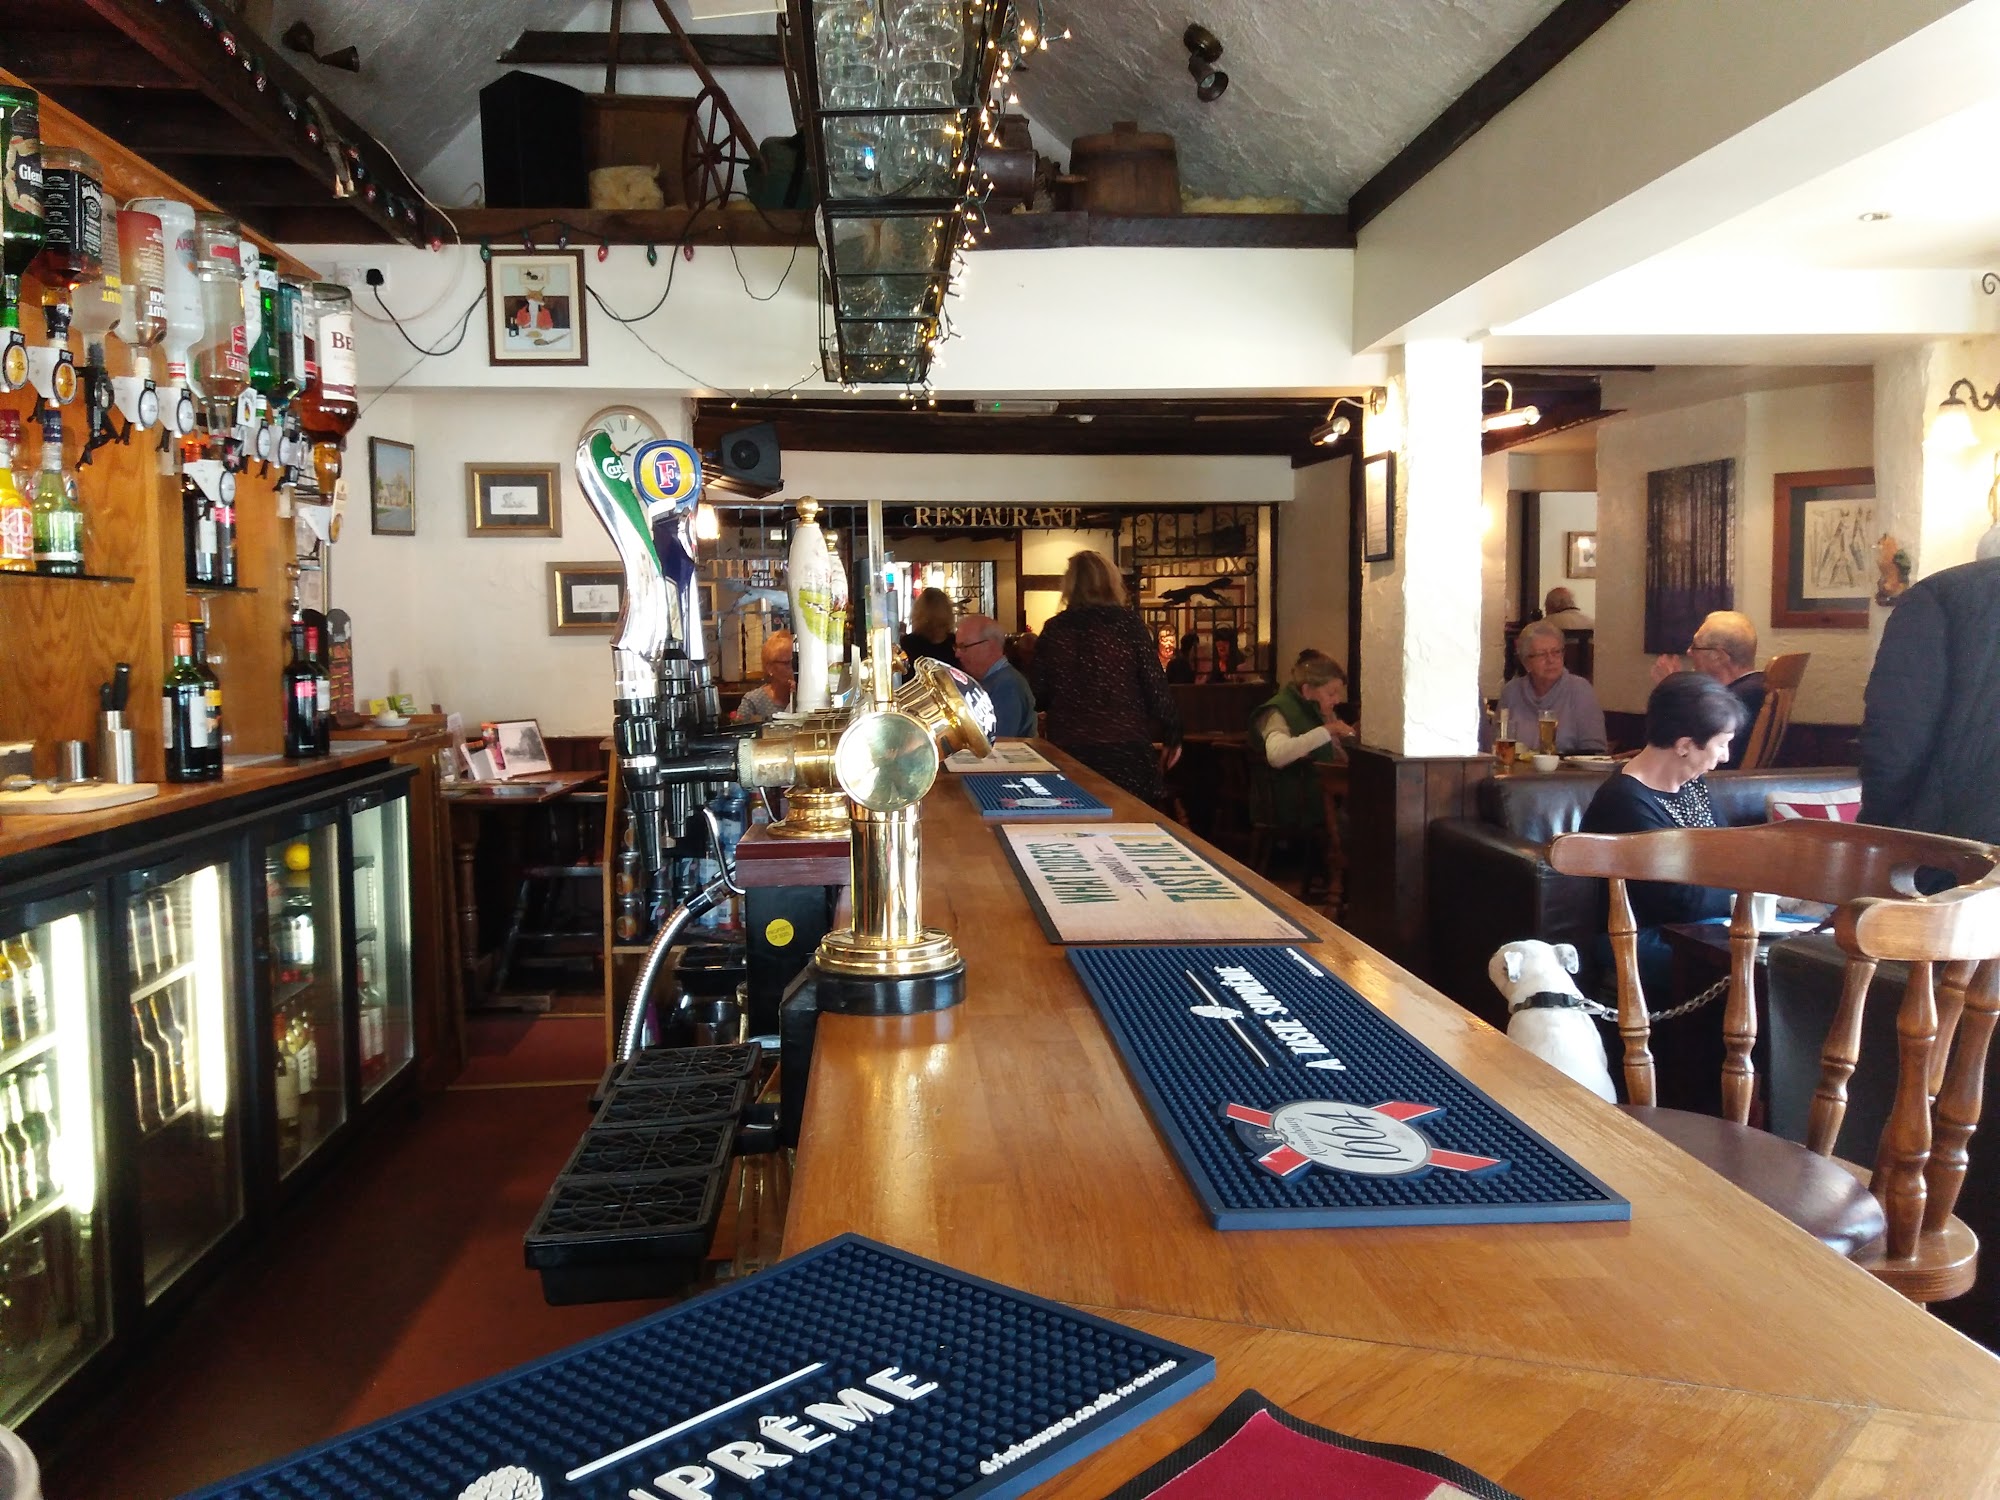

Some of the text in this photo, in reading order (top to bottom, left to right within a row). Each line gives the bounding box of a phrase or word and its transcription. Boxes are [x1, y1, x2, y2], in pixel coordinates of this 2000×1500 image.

[656, 459, 677, 488] F
[914, 506, 1082, 528] RESTAURANT
[1199, 556, 1242, 576] FOX
[1025, 842, 1095, 873] CIDER'S
[1115, 842, 1242, 902] TASTE LIKE
[1044, 875, 1120, 904] WHAT
[1264, 1018, 1330, 1055] TASTE
[1305, 1058, 1347, 1071] A
[1304, 1110, 1413, 1162] 1664
